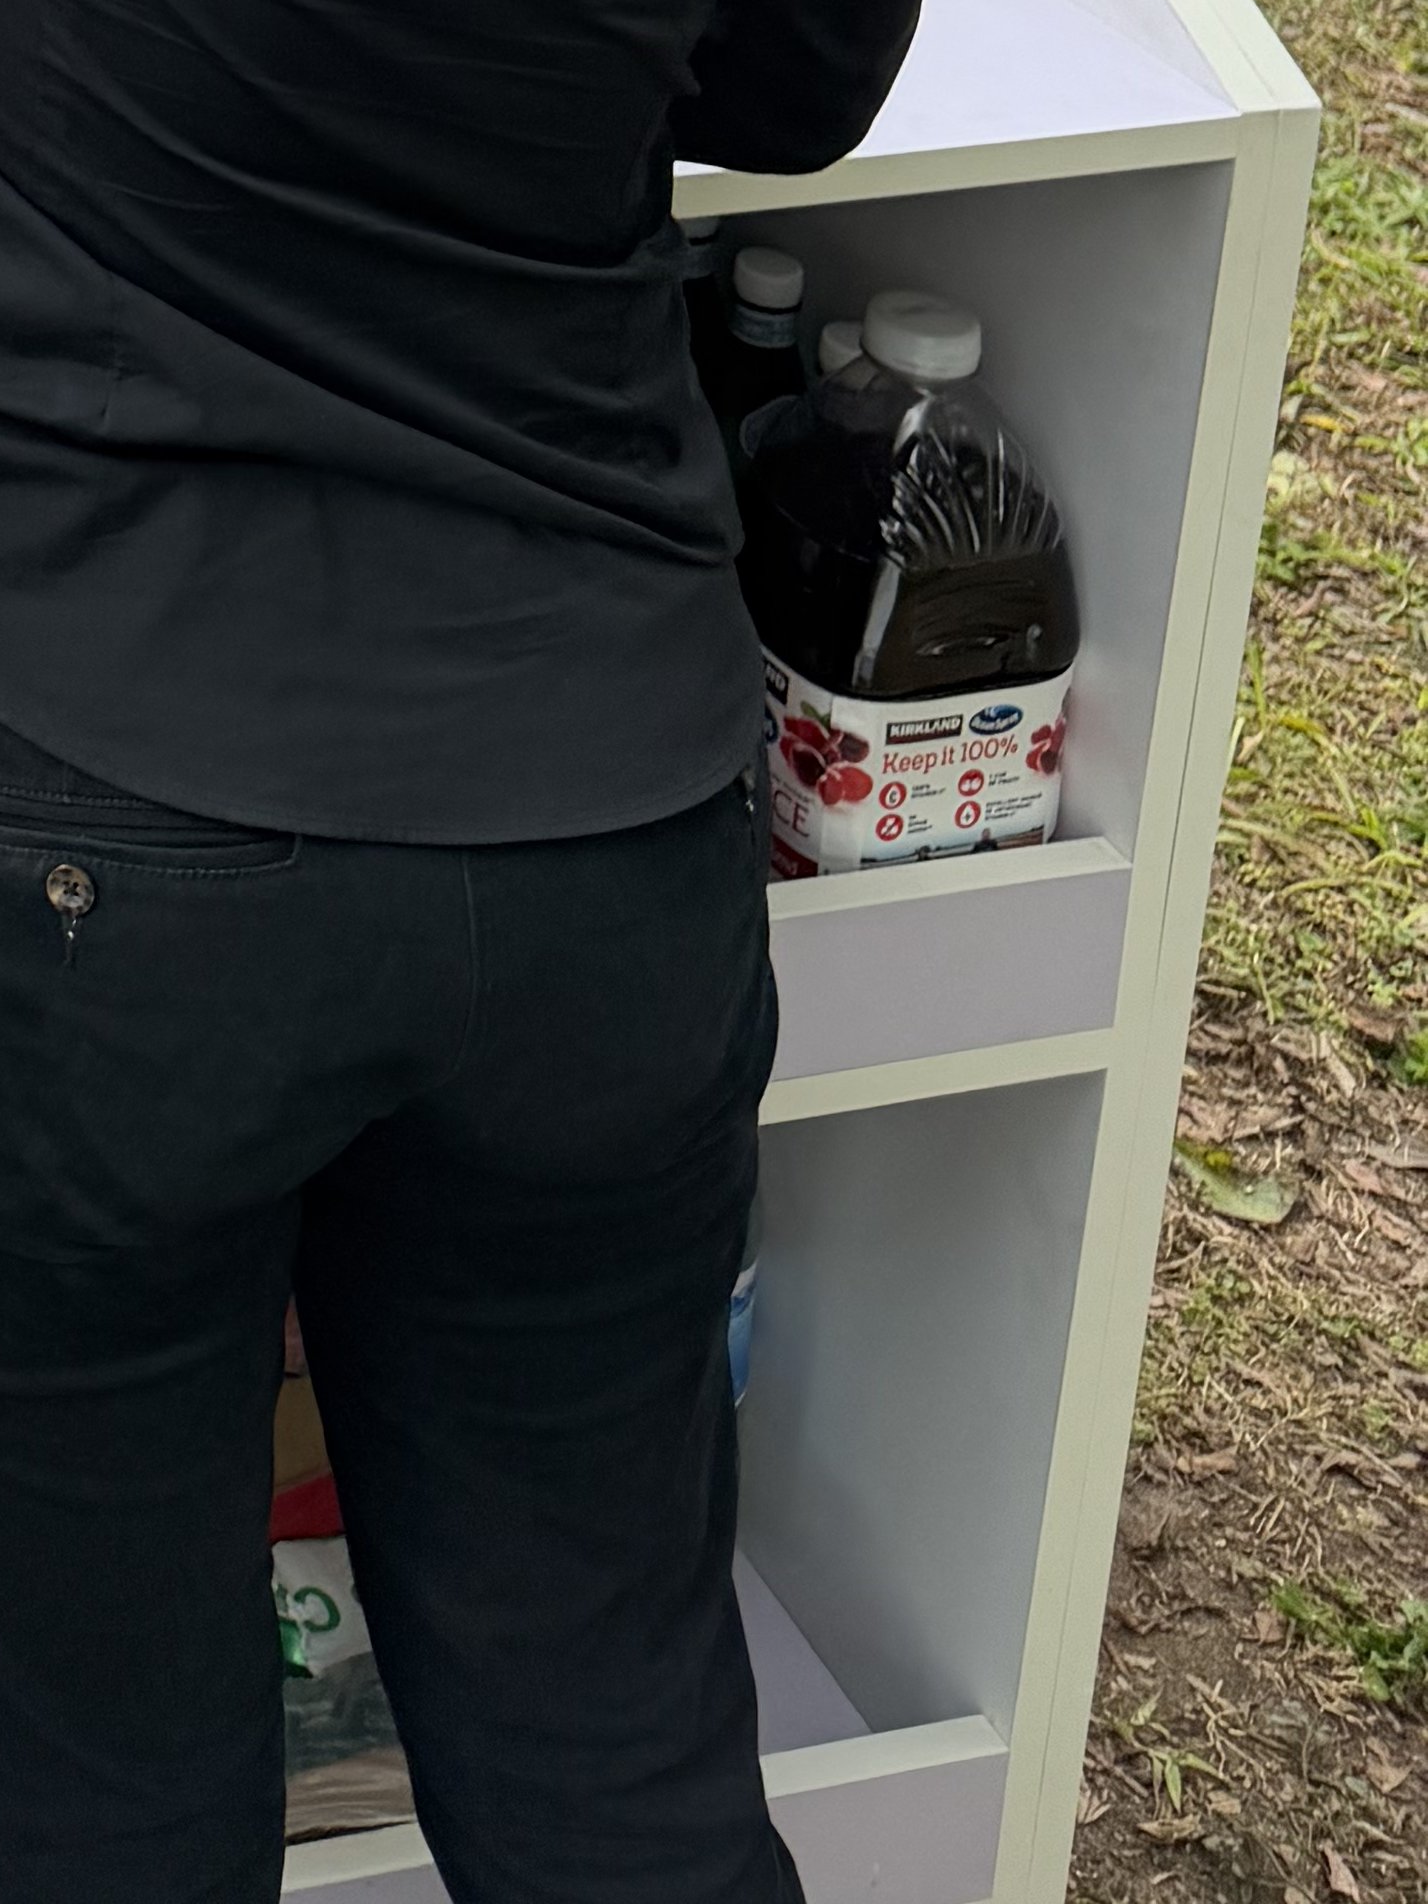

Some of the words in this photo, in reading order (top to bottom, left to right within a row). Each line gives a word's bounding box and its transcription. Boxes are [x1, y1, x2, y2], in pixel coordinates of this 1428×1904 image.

[889, 717, 961, 738] KIRKLAND
[881, 752, 937, 776] Keep
[941, 746, 955, 766] it
[961, 734, 1018, 763] 100%
